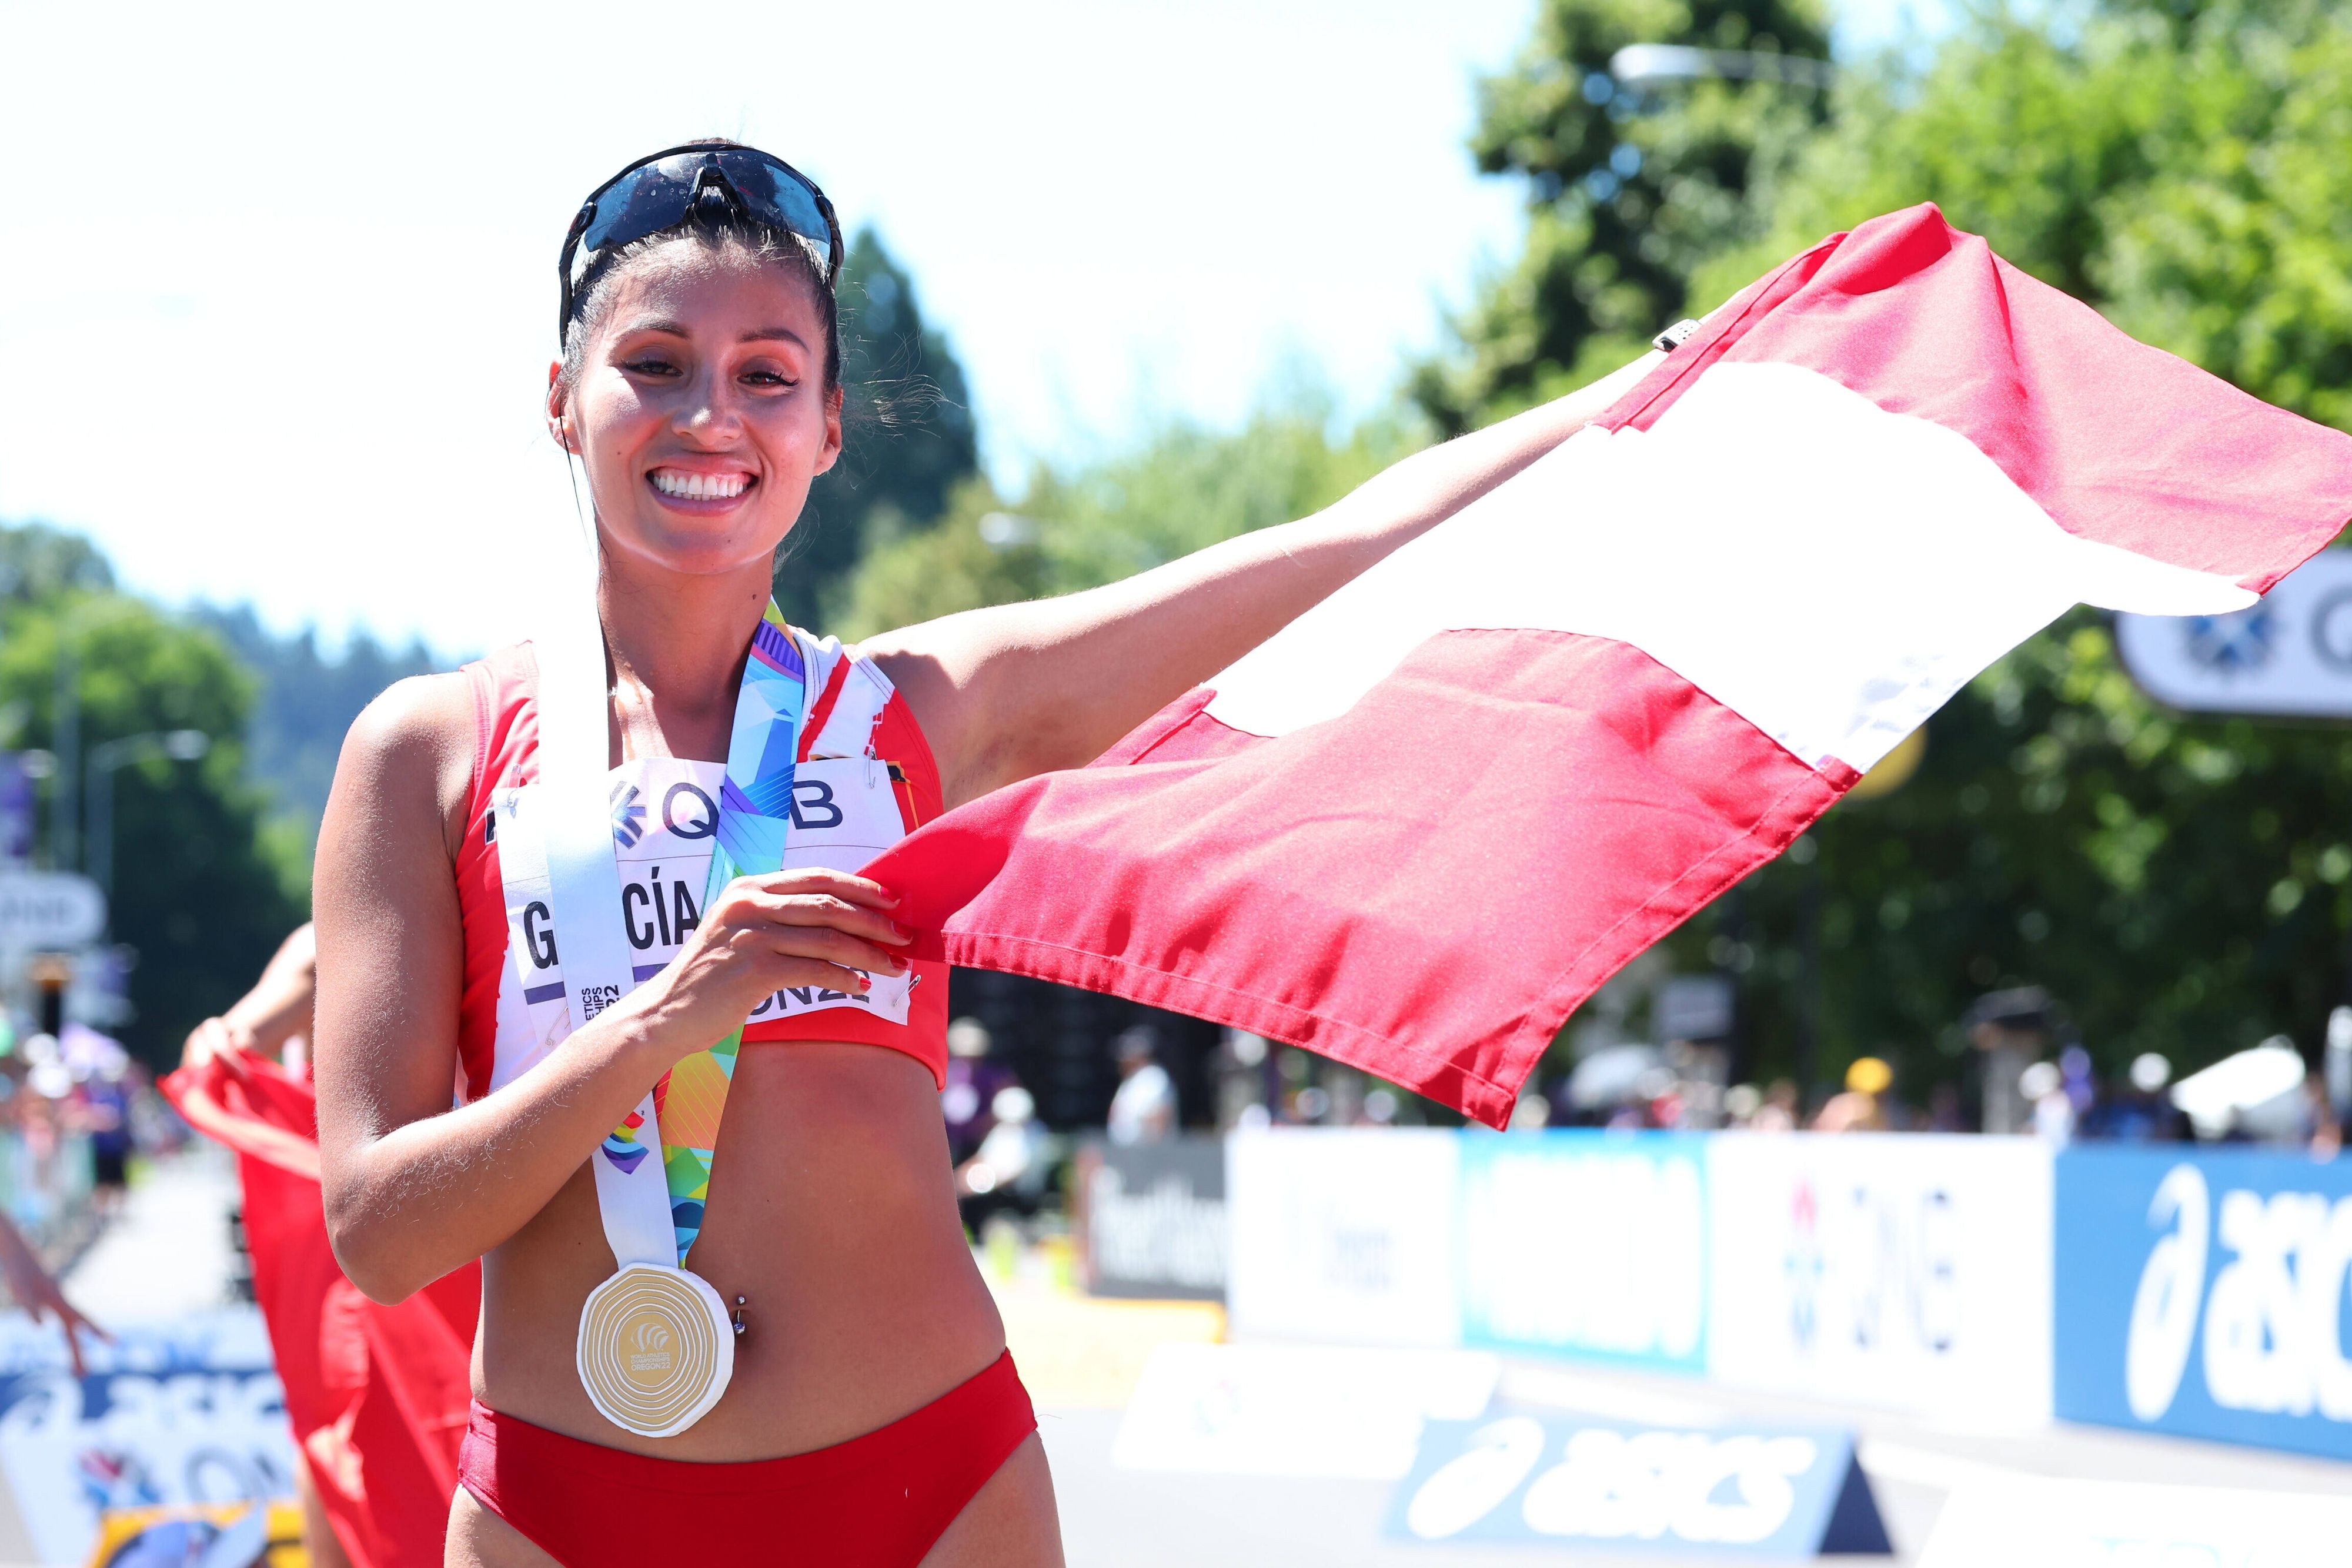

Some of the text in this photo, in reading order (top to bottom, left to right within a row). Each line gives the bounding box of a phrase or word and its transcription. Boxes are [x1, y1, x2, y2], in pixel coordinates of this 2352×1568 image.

[662, 780, 843, 840] QB
[524, 866, 700, 969] GCÍA
[582, 988, 595, 1021] ETICS
